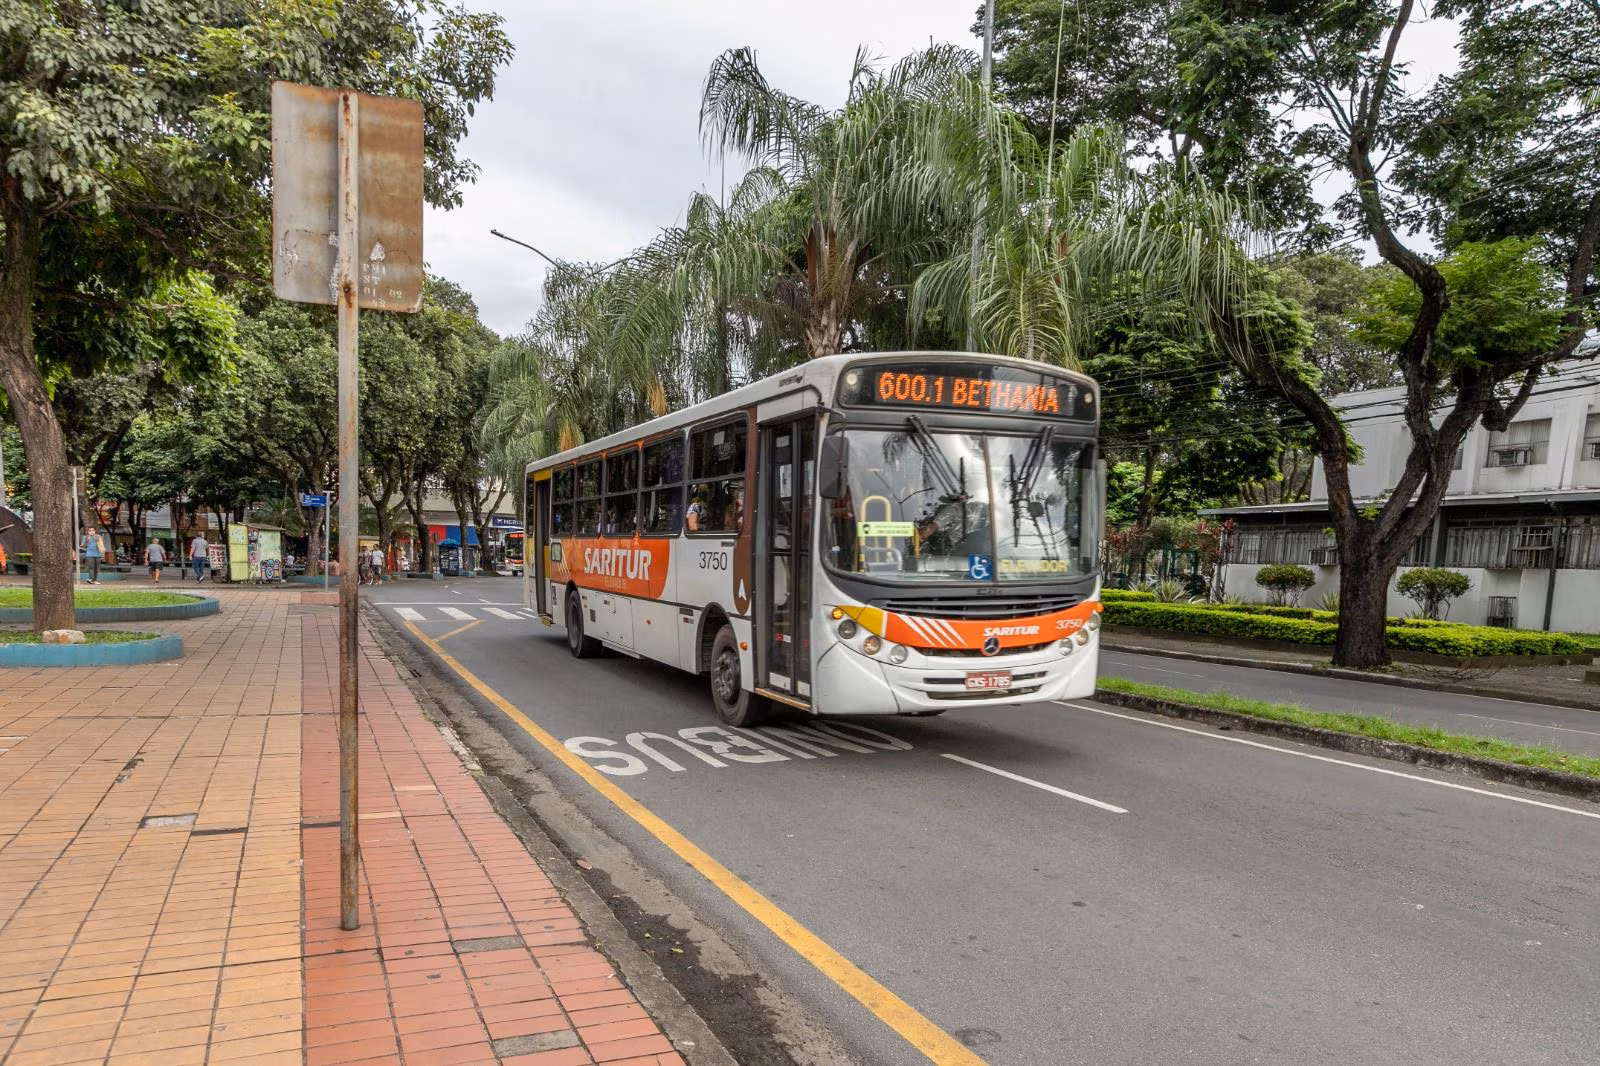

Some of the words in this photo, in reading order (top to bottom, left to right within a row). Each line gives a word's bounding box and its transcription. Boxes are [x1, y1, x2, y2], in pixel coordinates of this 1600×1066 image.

[879, 372, 944, 403] 600.1
[951, 378, 1060, 413] BETHANIA
[583, 547, 652, 581] SARITUR
[699, 551, 728, 571] 3750
[983, 625, 1040, 637] SARITUR
[1055, 618, 1084, 630] 3750
